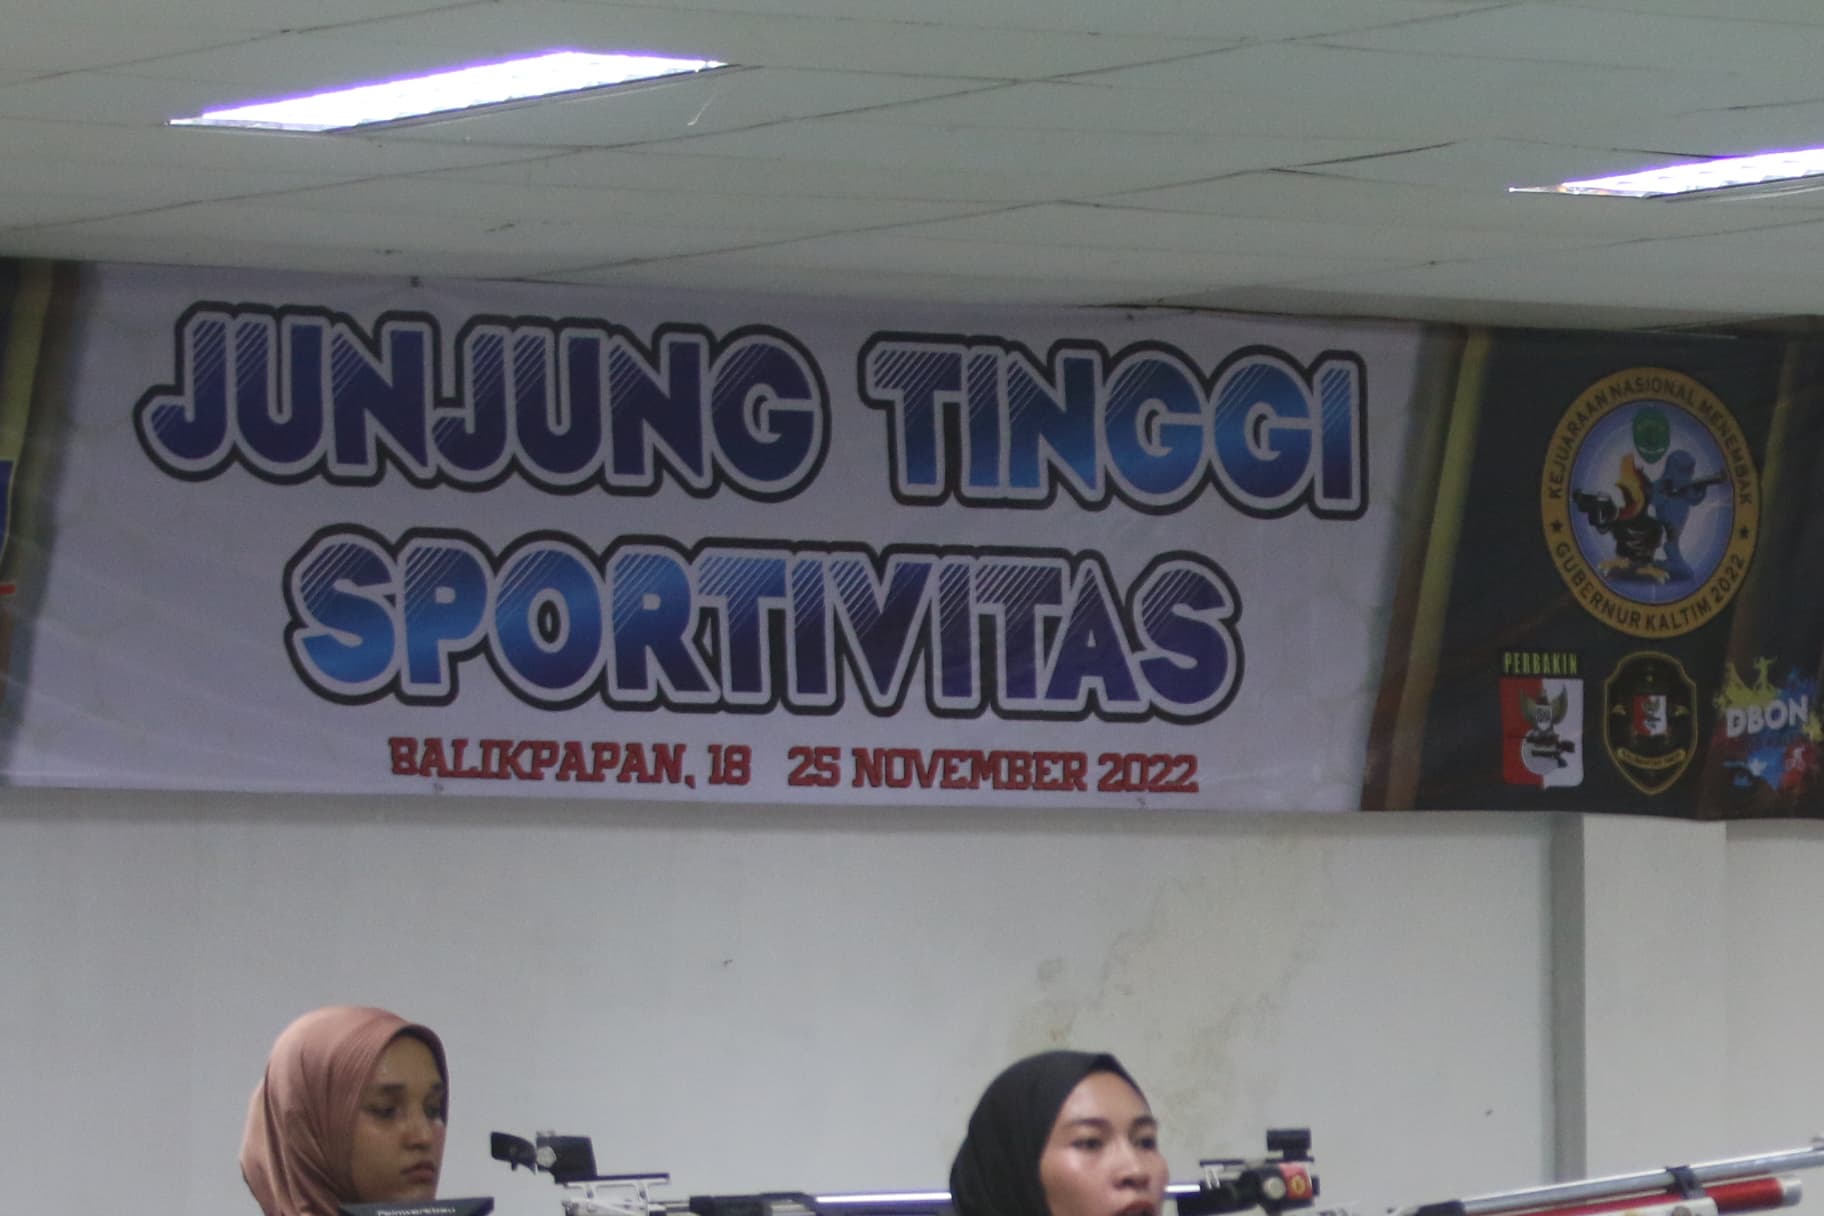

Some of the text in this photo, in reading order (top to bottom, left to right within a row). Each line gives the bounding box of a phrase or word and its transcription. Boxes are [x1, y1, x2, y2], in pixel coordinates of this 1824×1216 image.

[133, 300, 1369, 520] JUNJUNG TINGGI
[1549, 376, 1752, 504] KEJUARAAN NASIONAL MENEMBAK
[282, 523, 1245, 725] SPORTIVITAS
[1556, 543, 1745, 632] GUBERNUR KALTIM 2022
[1503, 651, 1578, 674] PERBAKIN
[1725, 694, 1808, 738] DBON
[389, 737, 1200, 794] BALIKPAPAN, 18 25 NOVEMBER 2022
